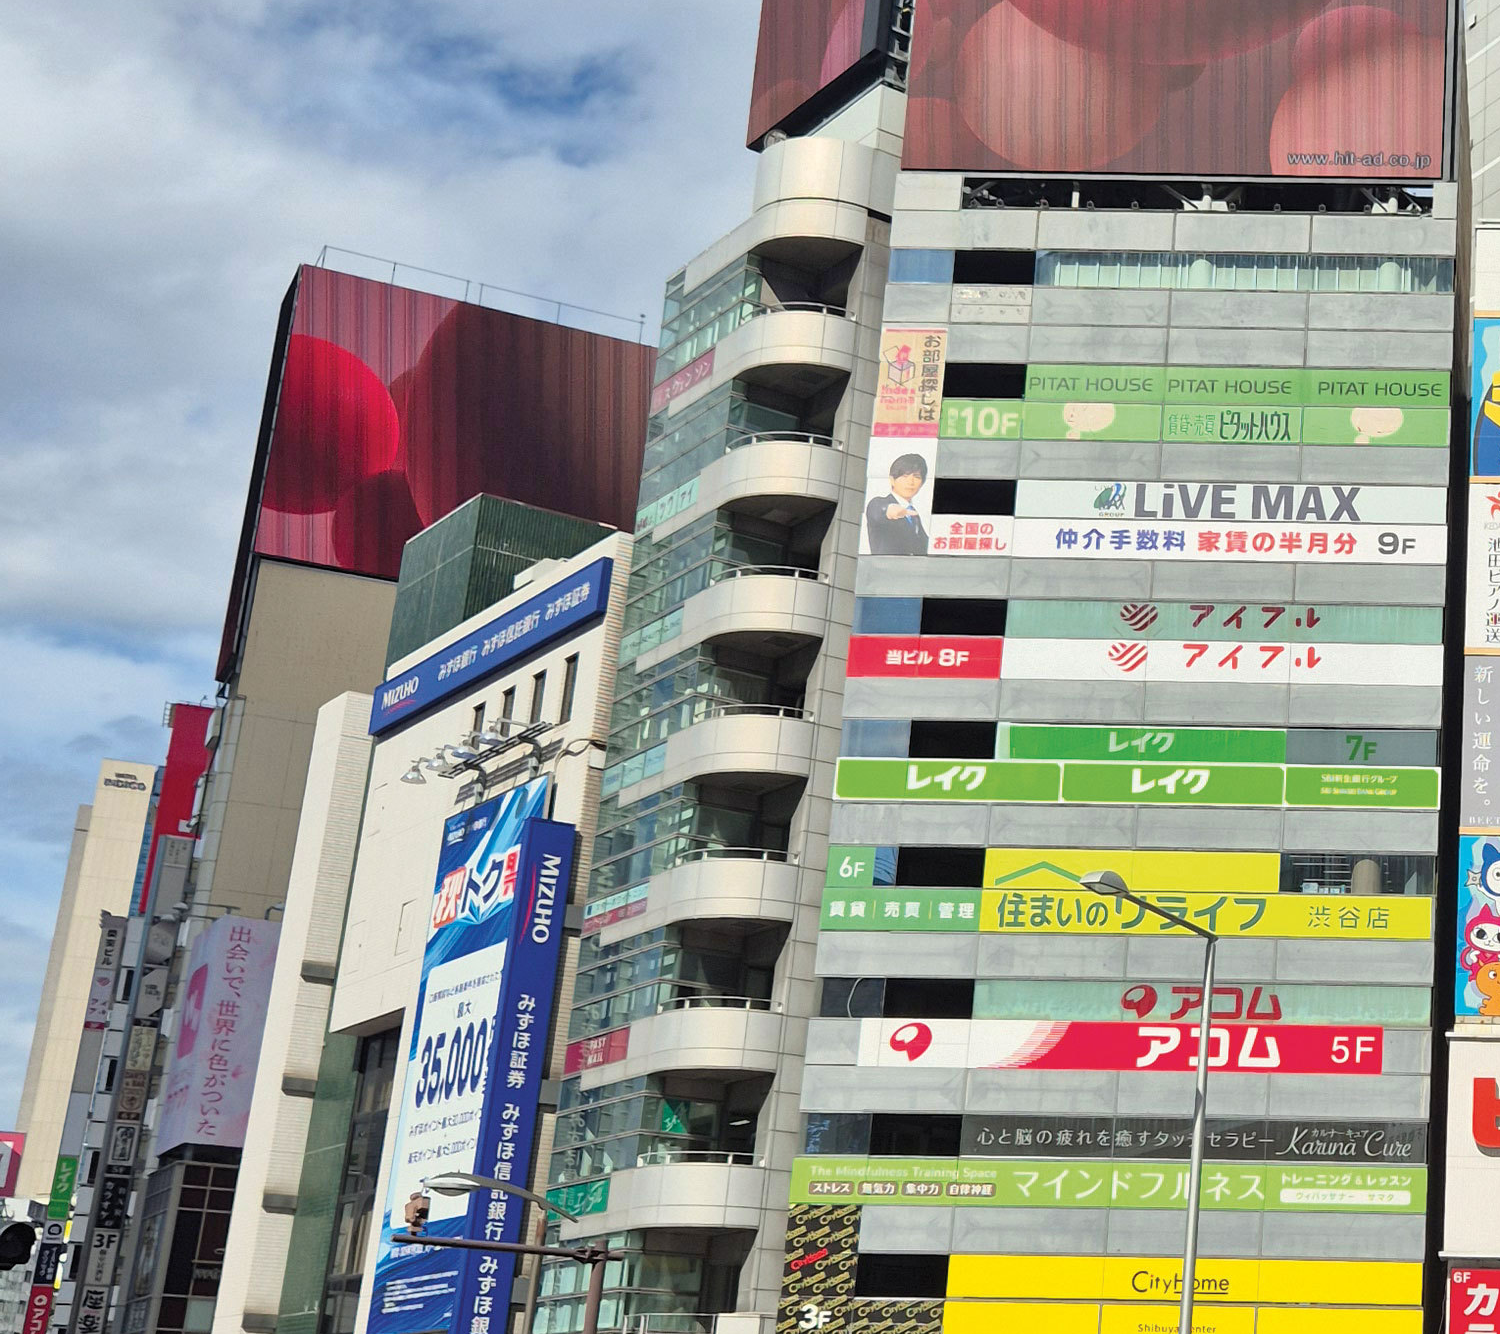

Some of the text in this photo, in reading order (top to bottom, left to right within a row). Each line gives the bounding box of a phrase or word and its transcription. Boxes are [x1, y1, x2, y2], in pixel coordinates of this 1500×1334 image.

[1287, 151, 1432, 168] www.hit-ad.co.jp
[1029, 376, 1154, 393] PITAT HOUSE
[1168, 378, 1292, 395] PITAT HOUSE
[1317, 380, 1443, 398] PITAT HOUSE
[1219, 409, 1291, 441] ピタットハウス
[1251, 485, 1361, 522] MAX
[949, 522, 994, 536] 全国の
[1055, 528, 1417, 556] 仲介手数料 家賃の半月分 9F
[933, 537, 1007, 552] お部屋探し
[1189, 604, 1322, 630] アイフル
[885, 649, 969, 667] 当ビル 8F
[1182, 643, 1322, 670] アイフル
[381, 675, 420, 710] MIZUHO
[1108, 731, 1174, 754] レイク
[1345, 735, 1378, 761] 7F
[1471, 665, 1494, 807] 新しい運命を。
[906, 765, 985, 791] レイク
[1130, 767, 1210, 794] レイク
[839, 857, 866, 879] 6F
[531, 853, 562, 945] MIZUHO
[829, 899, 975, 920] 賃貸 売買 管理
[1308, 906, 1391, 929] 渋谷店
[1170, 985, 1283, 1021] アコム
[196, 925, 252, 1137] 出会いで、世界に色がついた
[505, 993, 537, 1089] みずほ証券
[1136, 1026, 1376, 1068] アコム 5F
[810, 1165, 997, 1180] The Mindfulness Training Space
[1013, 1168, 1267, 1202] マインドフルネス
[812, 1183, 851, 1194] ストレス
[93, 1233, 117, 1249] 3F
[1453, 1271, 1471, 1284] 6F
[799, 1303, 832, 1329] 3F
[1137, 1323, 1217, 1334] Shibuya enter
